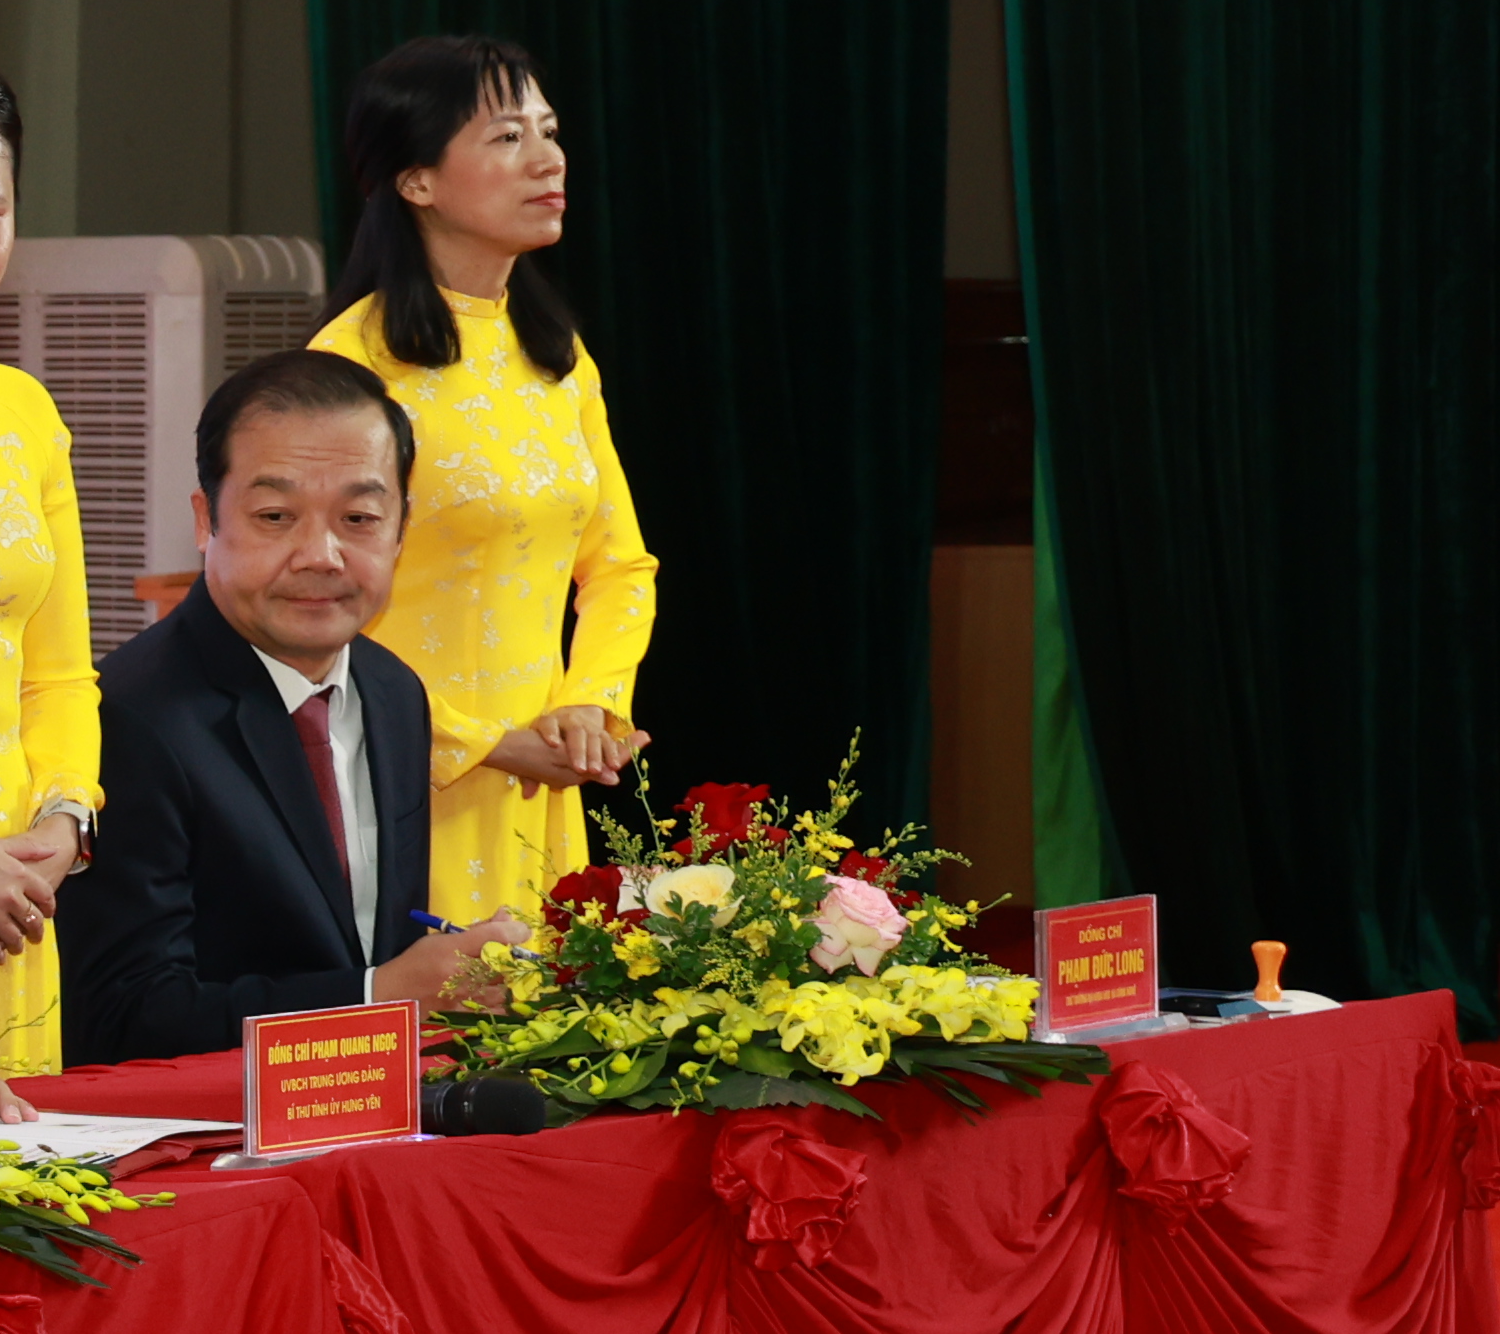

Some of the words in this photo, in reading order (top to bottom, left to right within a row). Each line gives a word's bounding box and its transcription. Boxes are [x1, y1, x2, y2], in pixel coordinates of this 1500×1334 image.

[1107, 920, 1123, 939] CHÍ
[1058, 956, 1091, 989] PHẠM
[1092, 948, 1114, 980] ĐỨC
[1115, 948, 1145, 977] LONG
[268, 1039, 293, 1065] ĐỒNG
[295, 1038, 310, 1062] CHÍ
[312, 1038, 338, 1063] PHẠM
[340, 1034, 371, 1058] QUANG
[373, 1032, 398, 1056] NGỌC
[281, 1075, 308, 1092] UVBCH
[309, 1072, 335, 1089] TRUNG
[361, 1064, 385, 1083] ĐẢNG
[365, 1093, 381, 1110] YÊN
